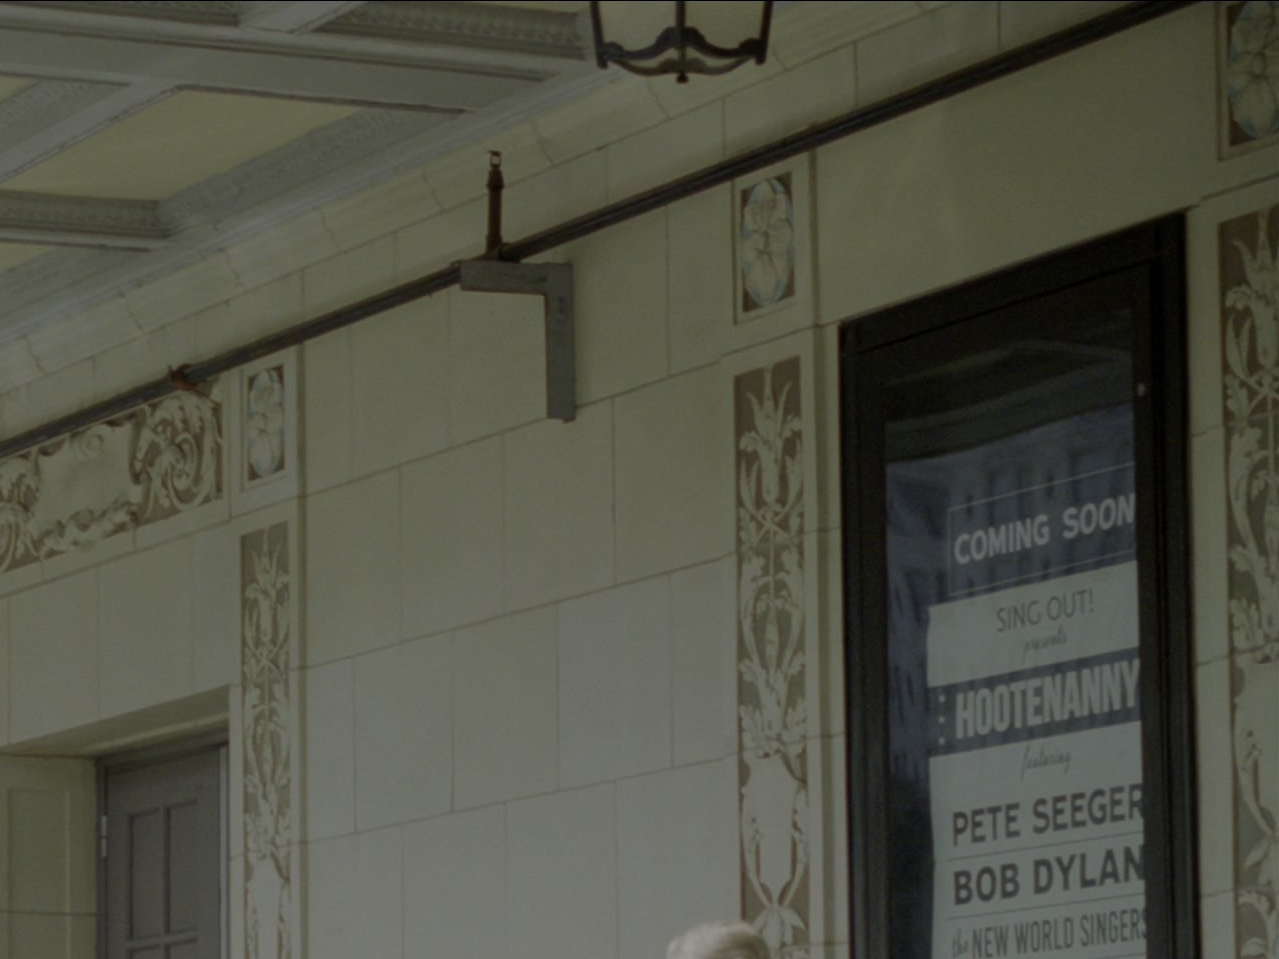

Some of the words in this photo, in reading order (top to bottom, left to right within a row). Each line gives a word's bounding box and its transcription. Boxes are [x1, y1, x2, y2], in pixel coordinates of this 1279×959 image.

[953, 514, 1050, 565] COMING
[1062, 493, 1136, 540] SOON
[996, 600, 1041, 632] SING
[1046, 588, 1094, 621] OUT!
[1022, 624, 1067, 662] presents
[955, 657, 1140, 740] HOOTENANNY
[1021, 744, 1072, 781] featuring
[952, 801, 1021, 847] PETE
[1032, 783, 1143, 835] SEEGER
[953, 863, 1020, 905] BOB
[1033, 844, 1145, 895] DYLAN
[952, 927, 969, 959] the
[972, 923, 1009, 959] NEW
[1013, 915, 1074, 955] WORLD
